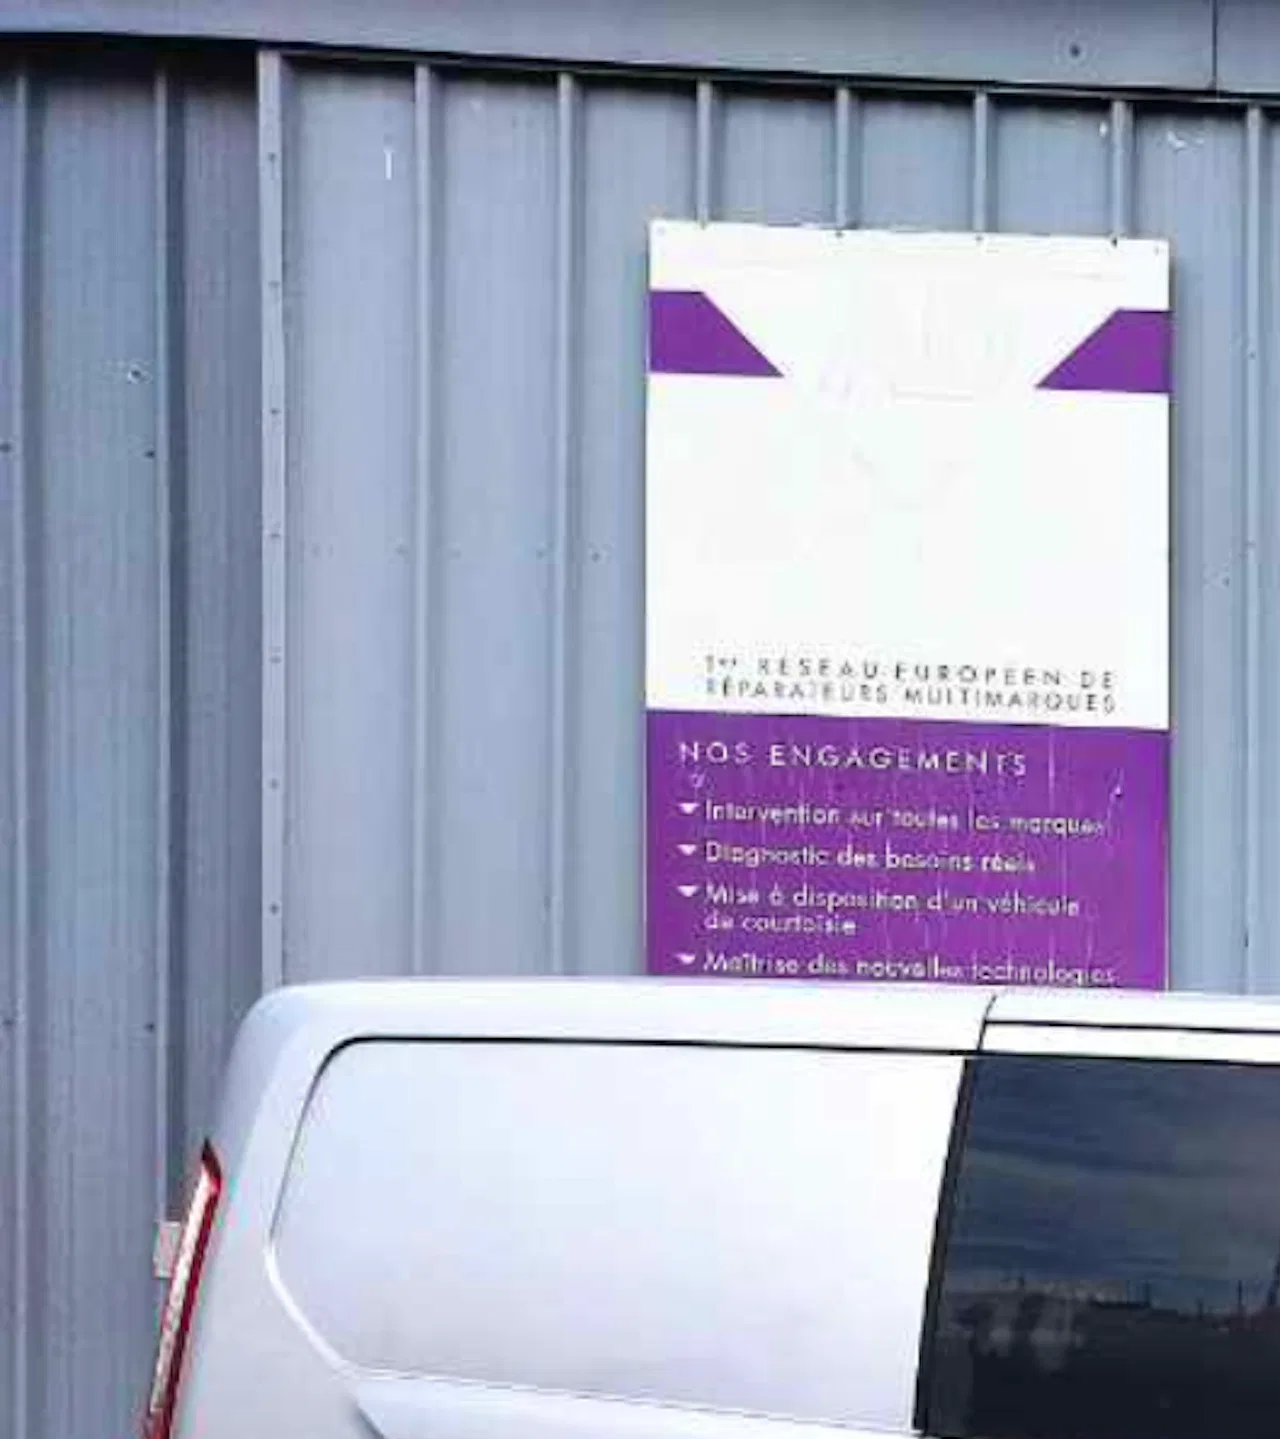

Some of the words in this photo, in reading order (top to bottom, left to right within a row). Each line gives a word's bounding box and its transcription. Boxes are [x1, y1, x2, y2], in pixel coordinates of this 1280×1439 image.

[1080, 669, 1115, 690] DE
[904, 687, 1115, 714] MULTIMARQUES
[680, 741, 750, 766] NOS
[769, 743, 1027, 777] ENGAGEMENTS
[705, 800, 841, 826] Intervention
[851, 808, 883, 828] sur
[705, 840, 830, 869] Diagnostic
[837, 843, 879, 869] des
[705, 881, 760, 906] Mise
[792, 882, 920, 913] disposition
[926, 885, 979, 913] d'un
[987, 888, 1081, 917] véhicule
[704, 907, 735, 930] de
[741, 913, 857, 937] courtoisie
[808, 952, 850, 976] des
[972, 957, 1117, 986] technologies
